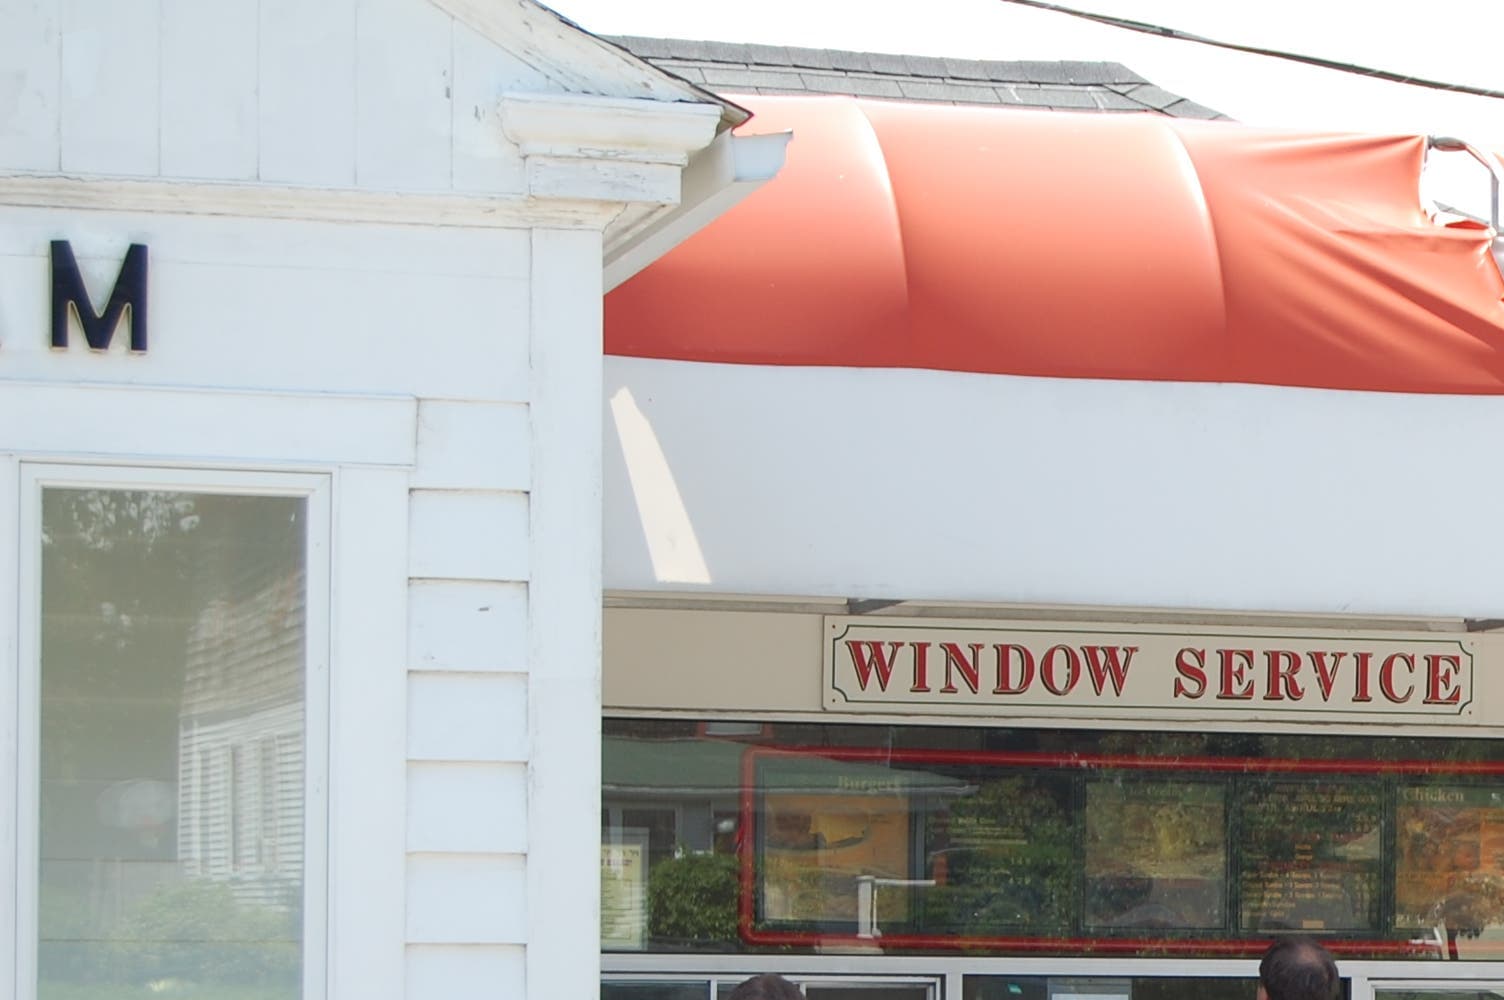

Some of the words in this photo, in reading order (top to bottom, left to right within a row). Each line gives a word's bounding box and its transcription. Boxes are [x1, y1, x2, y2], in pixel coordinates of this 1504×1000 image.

[846, 640, 1140, 698] WINDOW
[1174, 647, 1462, 705] SERVICE
[1403, 786, 1465, 802] Chicken
